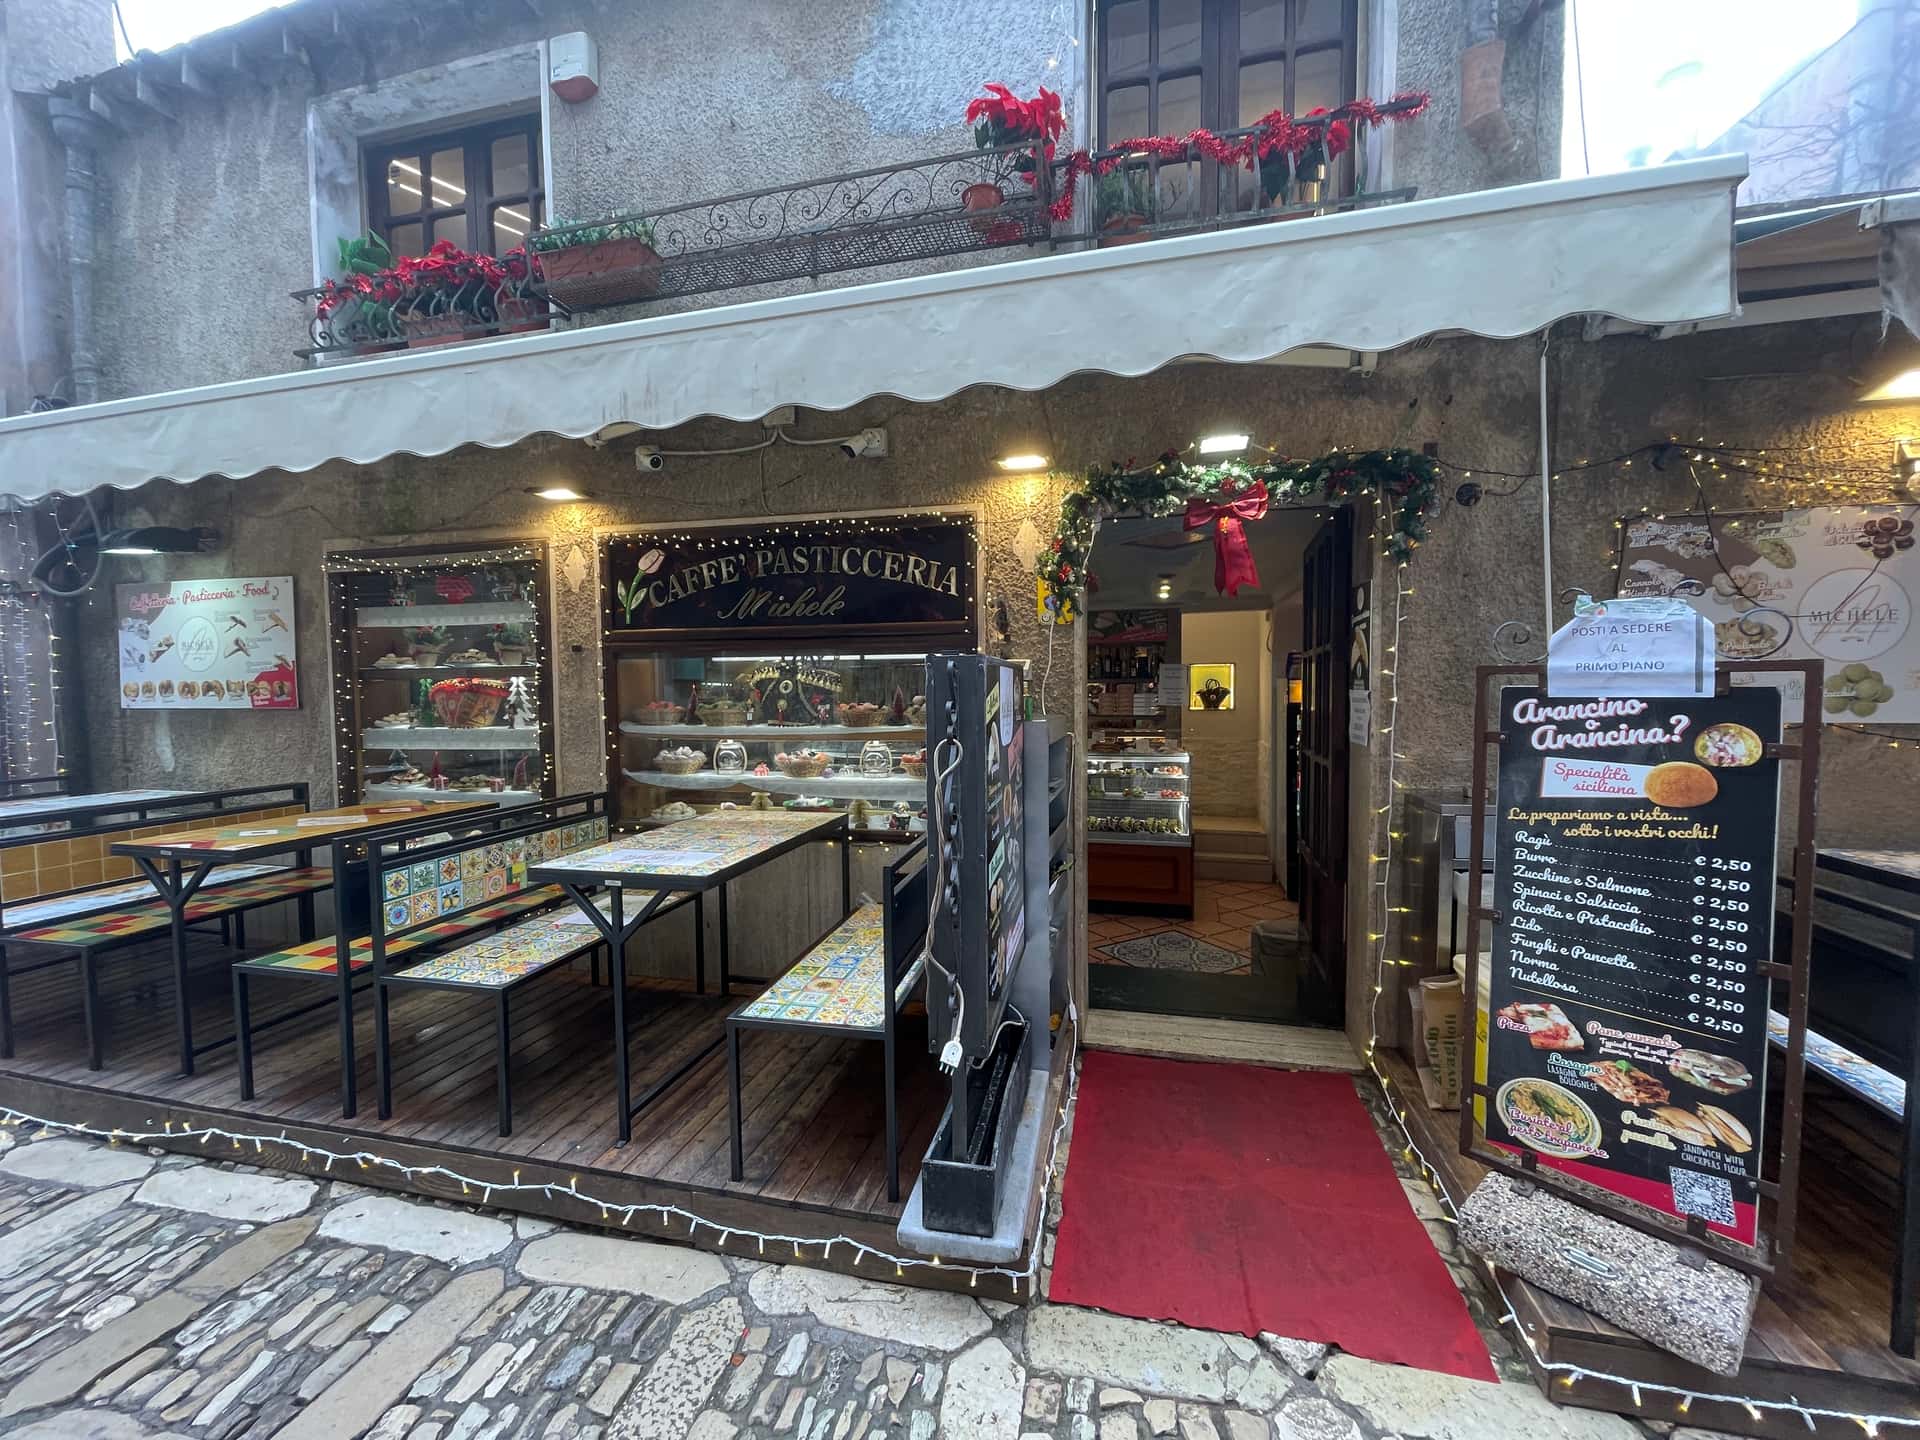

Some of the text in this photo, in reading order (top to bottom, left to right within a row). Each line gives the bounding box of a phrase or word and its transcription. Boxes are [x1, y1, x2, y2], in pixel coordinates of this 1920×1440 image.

[648, 546, 961, 609] CAFFE' PASTICCERIA
[182, 587, 235, 605] Pasticceria
[242, 580, 270, 596] Food
[717, 584, 846, 620] Michele
[1809, 609, 1899, 622] MICHELE
[1572, 622, 1673, 637] POSTI A SEDERE
[1611, 643, 1628, 653] AL
[1576, 660, 1665, 671] PRIMO PIANO
[1513, 697, 1648, 723] Arancino
[1531, 714, 1691, 750] Arancina?
[1585, 719, 1600, 730] o
[1554, 762, 1631, 781] Specialità
[1573, 778, 1637, 795] siciliana
[1507, 807, 1529, 820] La
[1528, 808, 1614, 825] prepariamo
[1563, 823, 1719, 839] sotto i vostri occhi!
[1515, 831, 1751, 872] Ragù € 2,50
[1514, 847, 1750, 892] Burro € 2,50
[1513, 865, 1749, 913] Zucchine e Salmone € 2,50
[1513, 882, 1749, 933] Spinaci e Salsiccia € 2,50
[1512, 899, 1748, 953] Ricotta e Pistacchio € 2,50
[1510, 916, 1747, 973] Lido € 2,50
[1510, 933, 1746, 993] Funghi e Pancetta € 2,50
[1510, 950, 1745, 1014] Norma € 2,50
[1509, 967, 1744, 1034] Nutellosa € 2,50
[1496, 1016, 1533, 1034] Pizza
[1586, 1020, 1623, 1039] Pane
[1547, 1052, 1605, 1077] Lasagne
[1547, 1064, 1578, 1079] LASAGNA
[1559, 1075, 1598, 1092] BOLOGNESE
[1546, 1130, 1610, 1159] trapanese
[1682, 1143, 1745, 1167] SANDWICH WITH
[1681, 1152, 1747, 1177] CHICKPEAS FLOUR
